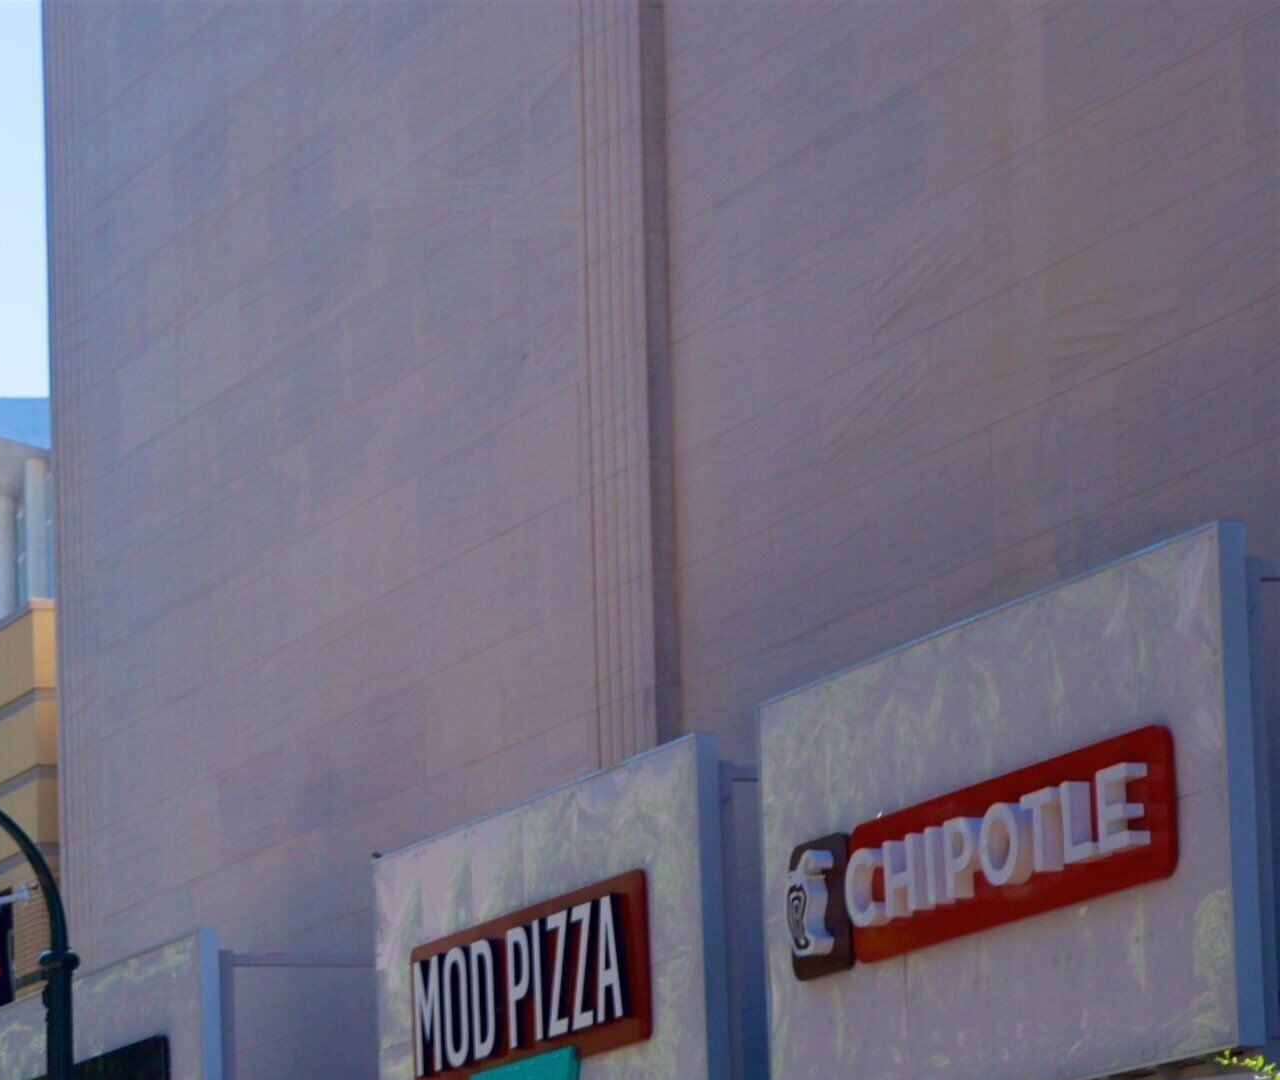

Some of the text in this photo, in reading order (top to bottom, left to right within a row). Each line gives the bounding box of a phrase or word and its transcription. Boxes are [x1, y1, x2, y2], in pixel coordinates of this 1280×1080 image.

[845, 762, 1152, 928] CHIPOTLE
[413, 895, 624, 1077] MOD PIZZA
